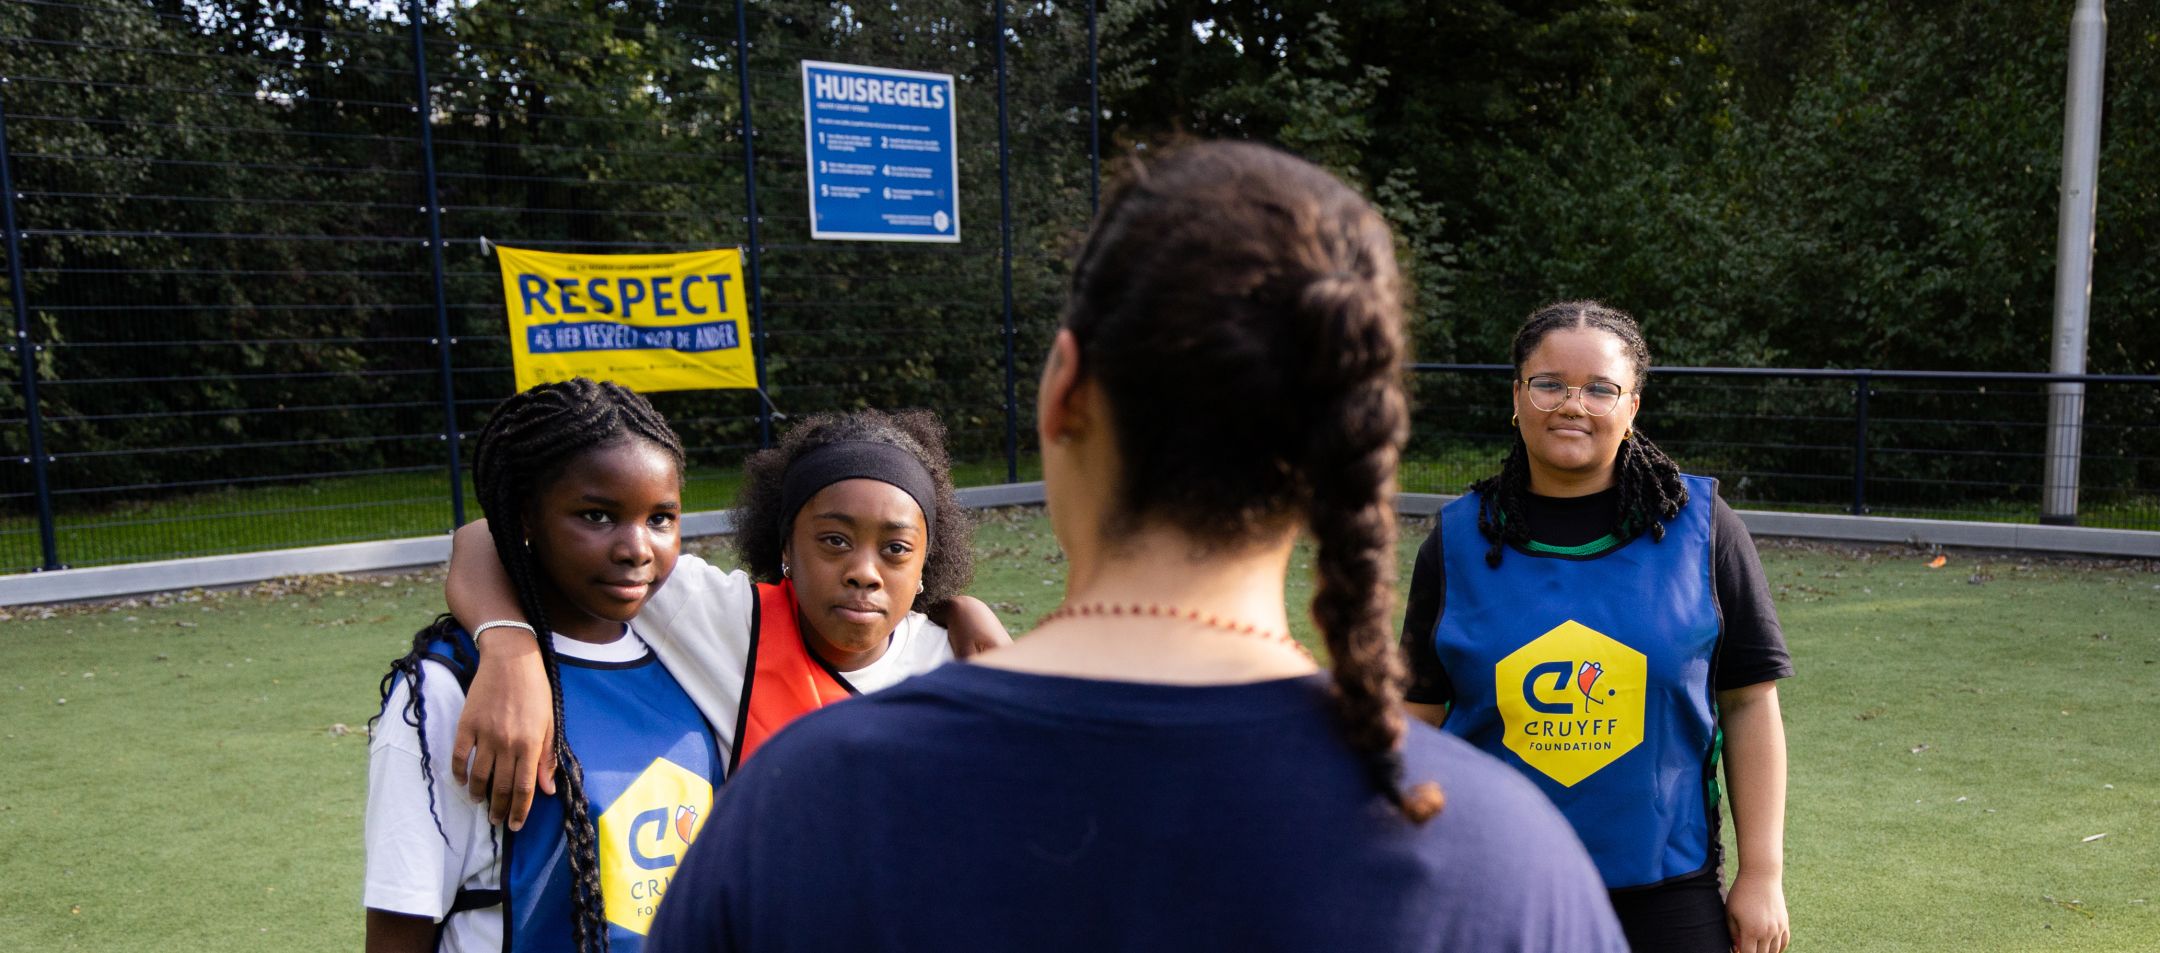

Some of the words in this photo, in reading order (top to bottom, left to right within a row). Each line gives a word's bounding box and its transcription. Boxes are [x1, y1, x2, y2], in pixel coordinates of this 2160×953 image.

[815, 74, 945, 109] HUISREGELS
[818, 131, 825, 144] 1
[880, 136, 889, 149] 2
[820, 160, 828, 174] 3
[518, 273, 732, 318] RESPECT
[556, 327, 581, 348] HEB
[695, 324, 736, 349] ANDER
[1524, 719, 1617, 737] CRUYFF
[1529, 742, 1612, 751] FOUNDATION
